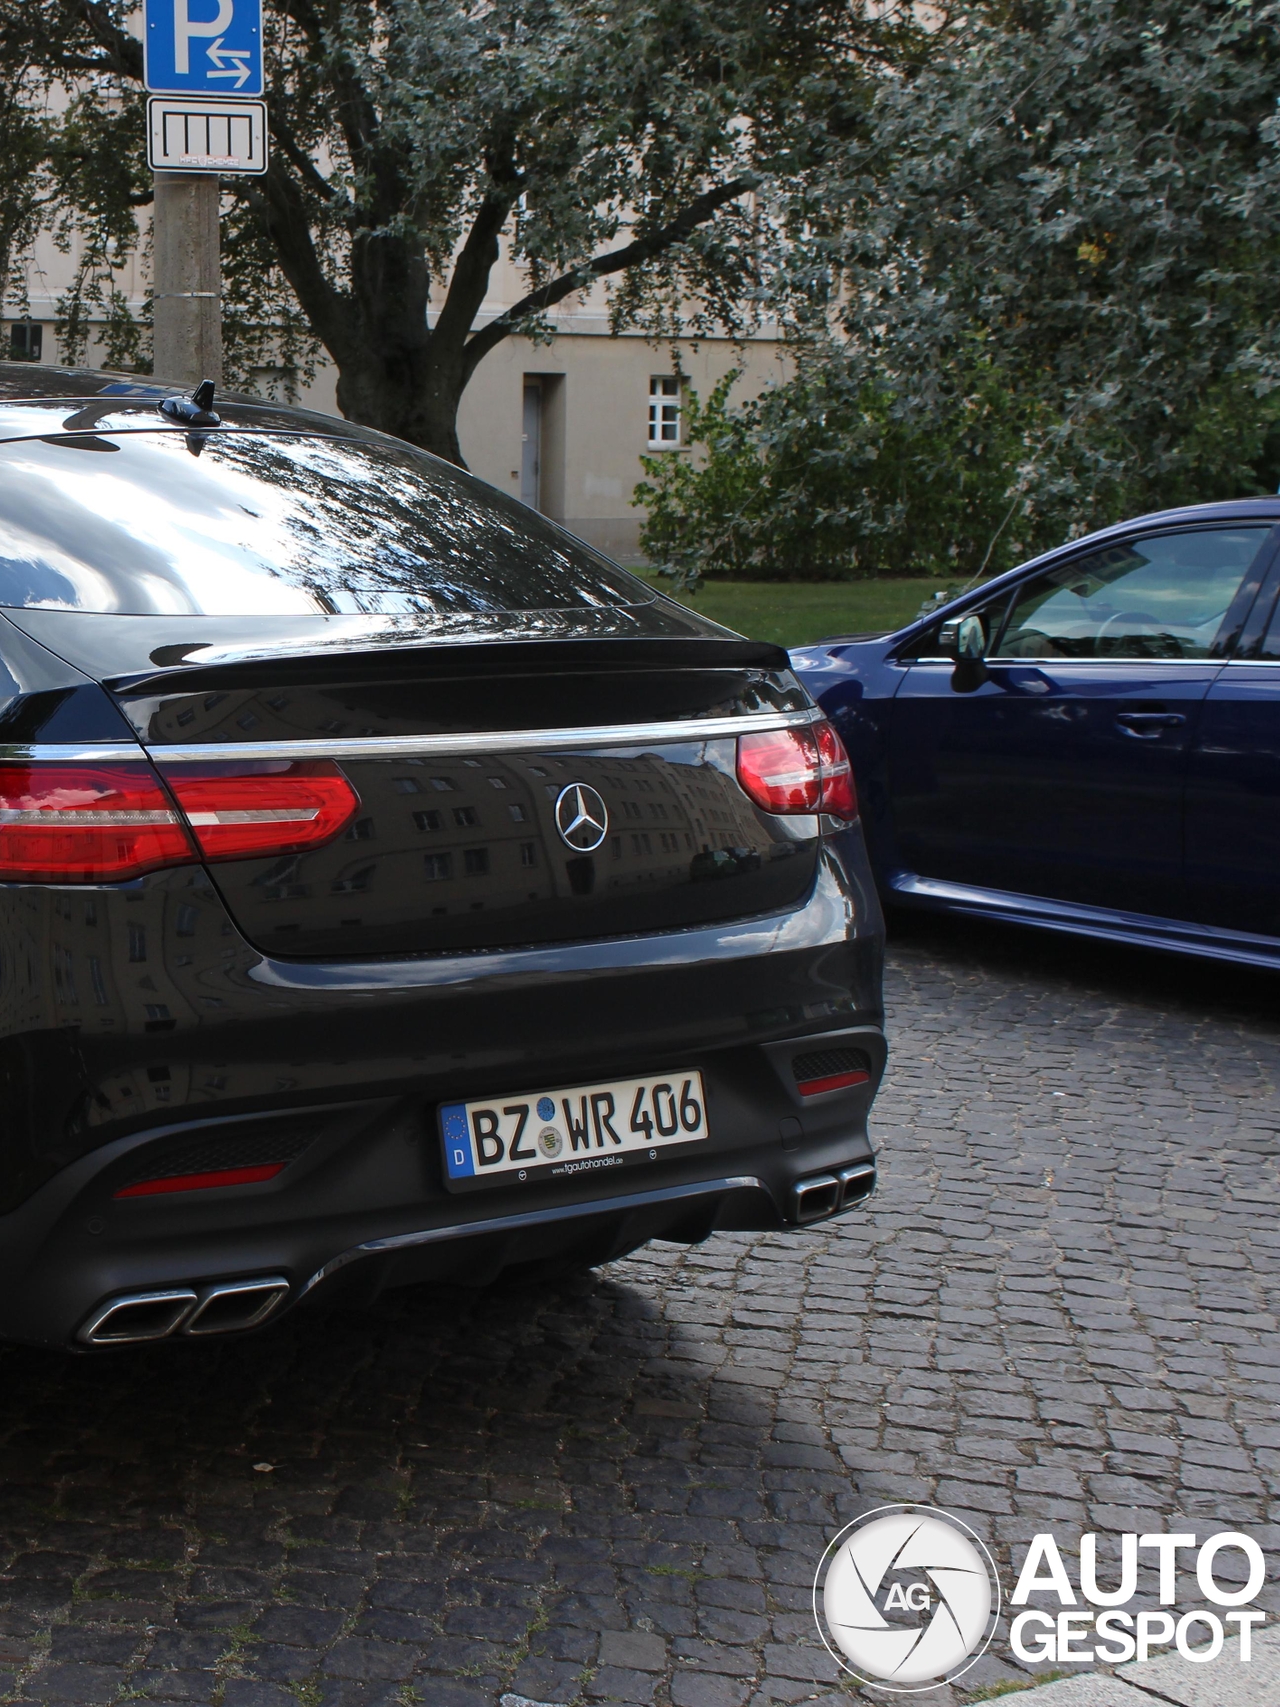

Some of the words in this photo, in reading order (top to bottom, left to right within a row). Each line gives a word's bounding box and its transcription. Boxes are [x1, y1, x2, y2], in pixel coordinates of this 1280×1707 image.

[173, 0, 234, 74] P
[471, 1103, 537, 1166] BZ
[562, 1091, 622, 1151] WR
[629, 1079, 702, 1140] 406
[453, 1149, 465, 1166] D
[551, 1155, 624, 1175] www.tgautohandel.de
